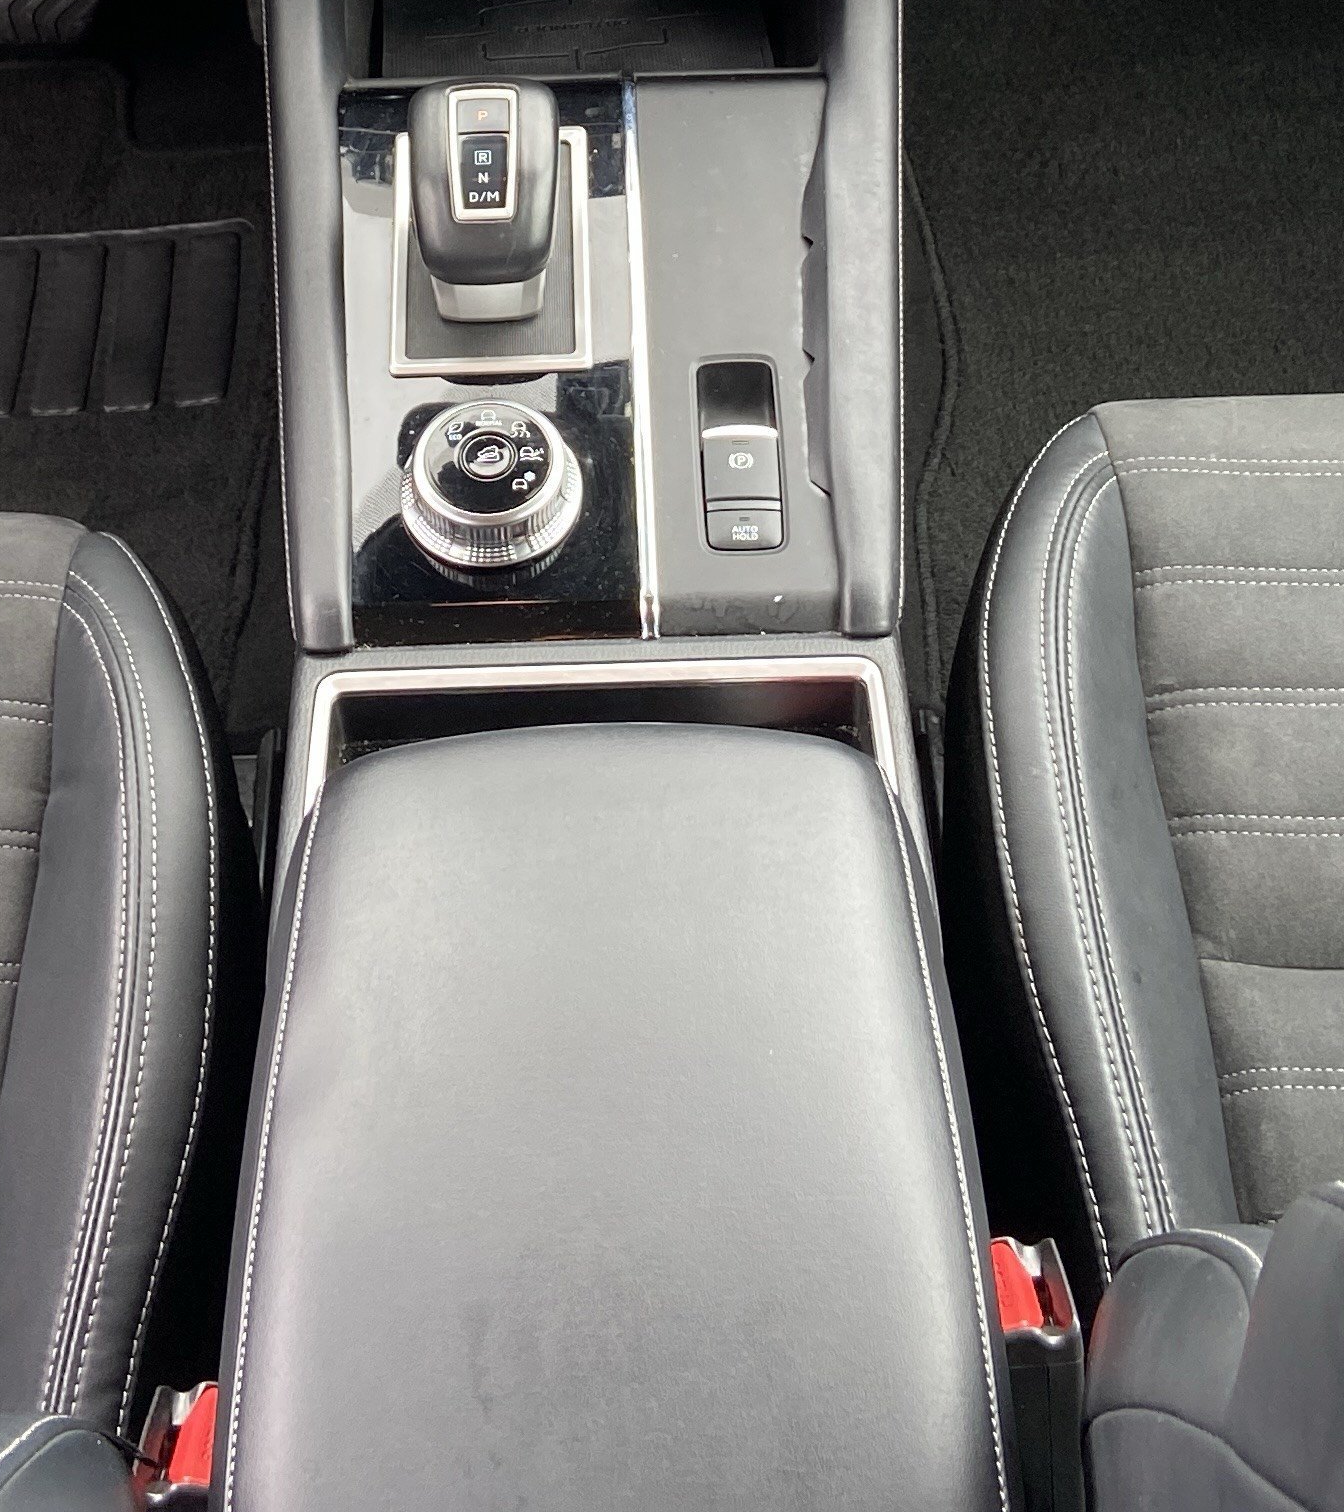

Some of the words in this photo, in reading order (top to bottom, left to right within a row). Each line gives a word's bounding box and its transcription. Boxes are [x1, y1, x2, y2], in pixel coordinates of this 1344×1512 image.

[477, 110, 488, 121] P
[478, 152, 488, 163] R
[477, 172, 489, 184] N
[468, 190, 500, 203] D/M
[731, 525, 758, 533] AUTO
[732, 533, 758, 541] HOLD
